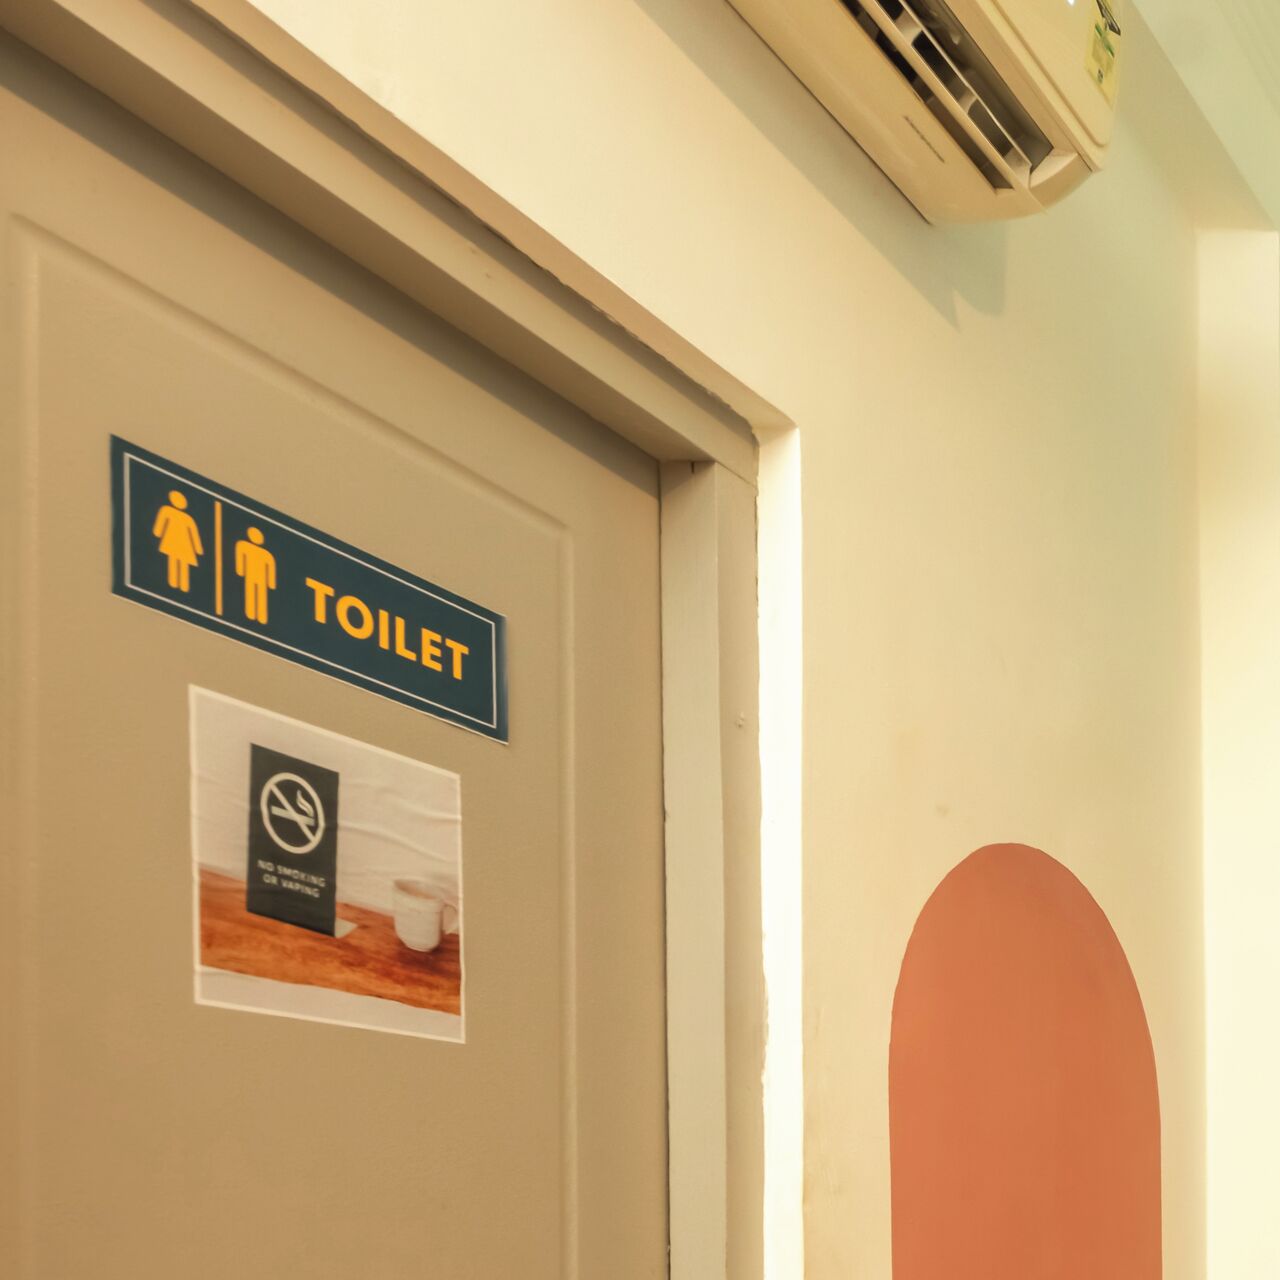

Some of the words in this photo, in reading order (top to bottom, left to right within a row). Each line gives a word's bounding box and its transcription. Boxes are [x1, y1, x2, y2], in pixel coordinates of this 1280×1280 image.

[305, 577, 469, 681] TOILET
[257, 859, 275, 872] NO
[276, 864, 326, 888] SMOKING
[262, 873, 278, 886] OR
[280, 878, 320, 898] VAPING
